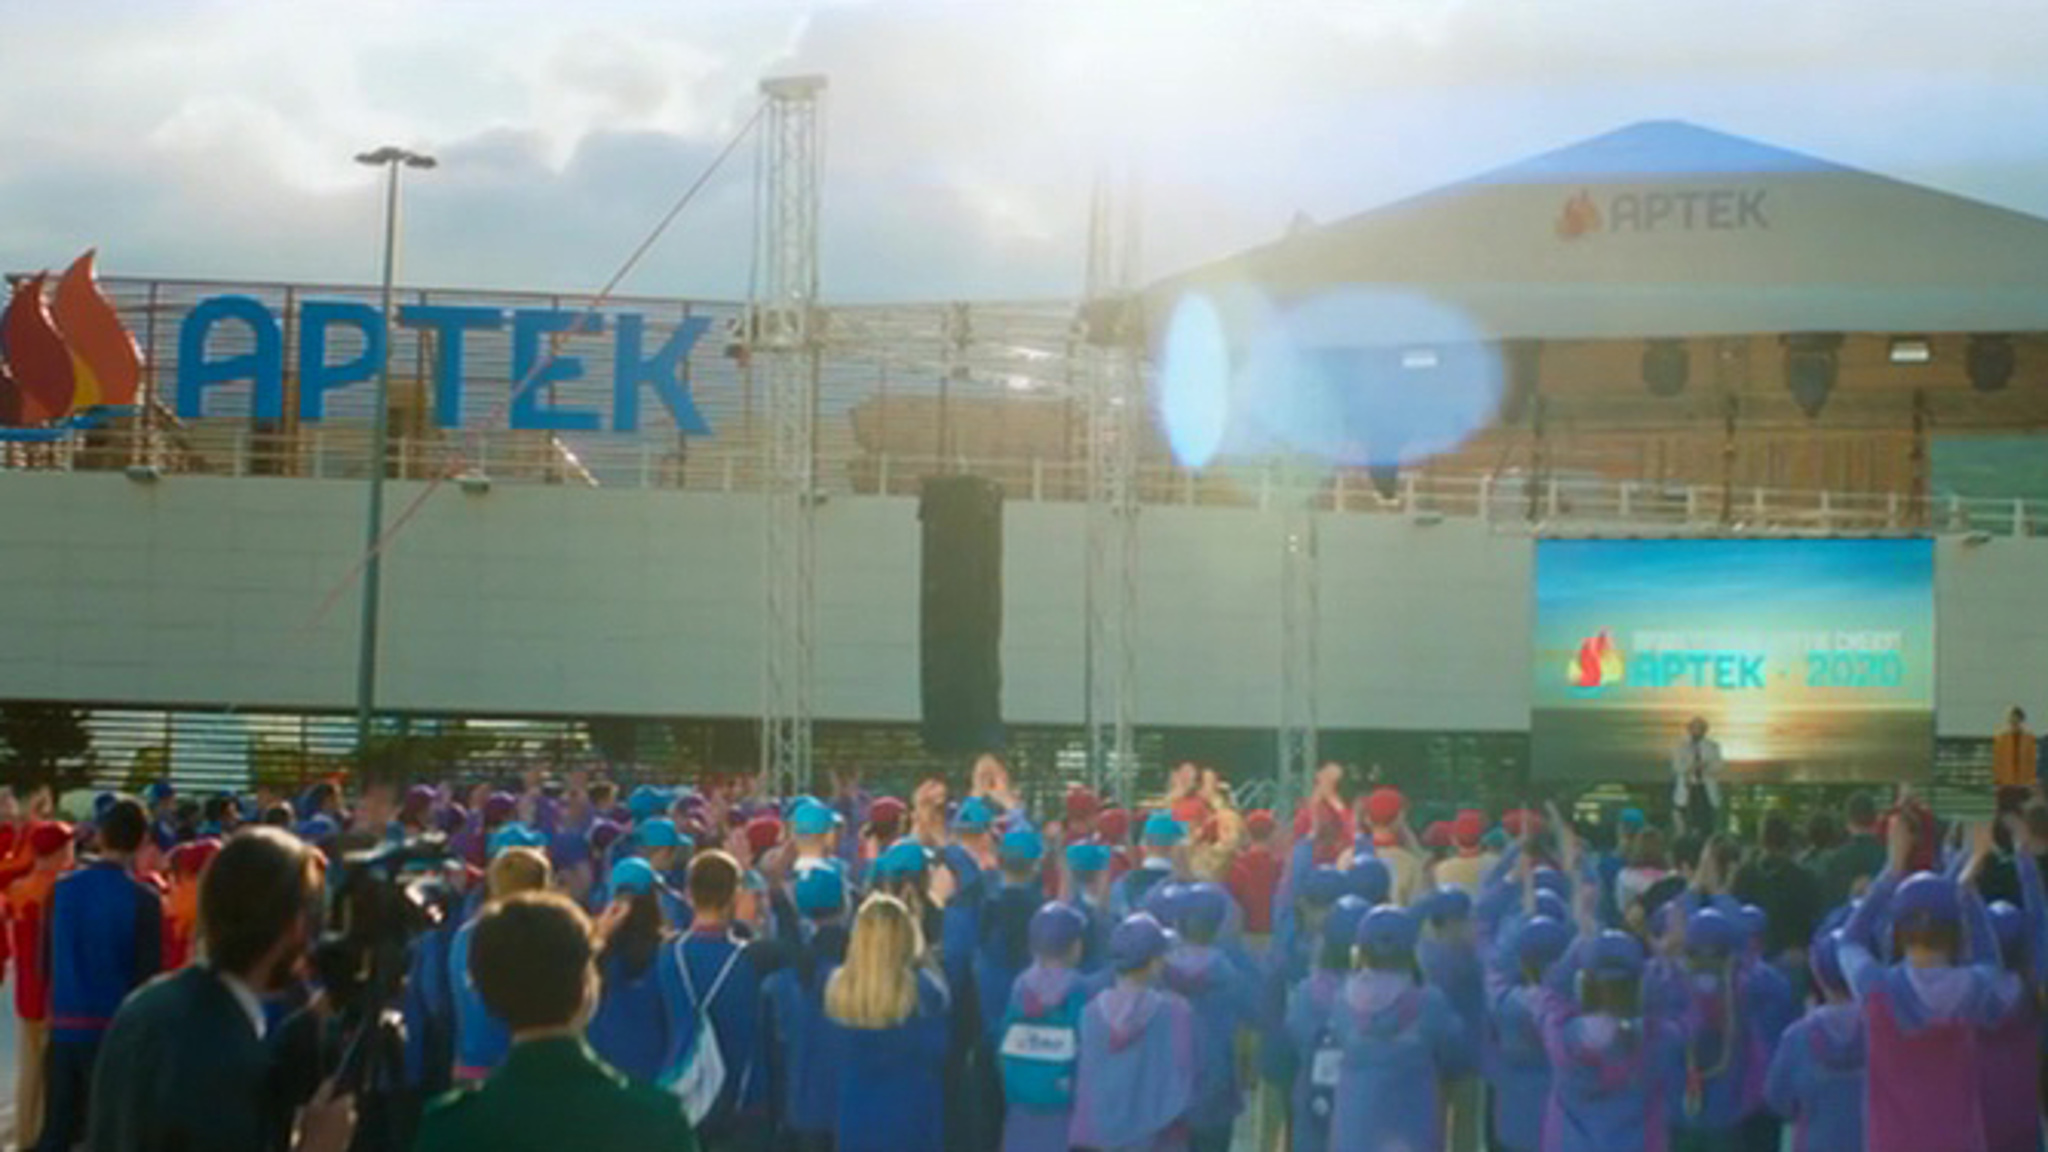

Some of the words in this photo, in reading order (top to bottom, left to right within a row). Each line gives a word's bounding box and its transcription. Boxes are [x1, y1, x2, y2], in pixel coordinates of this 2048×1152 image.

[1610, 189, 1770, 233] АРТЕК
[177, 295, 713, 436] АРТЕК
[1629, 651, 1765, 689] АРТЕК
[1807, 651, 1905, 687] 2020
